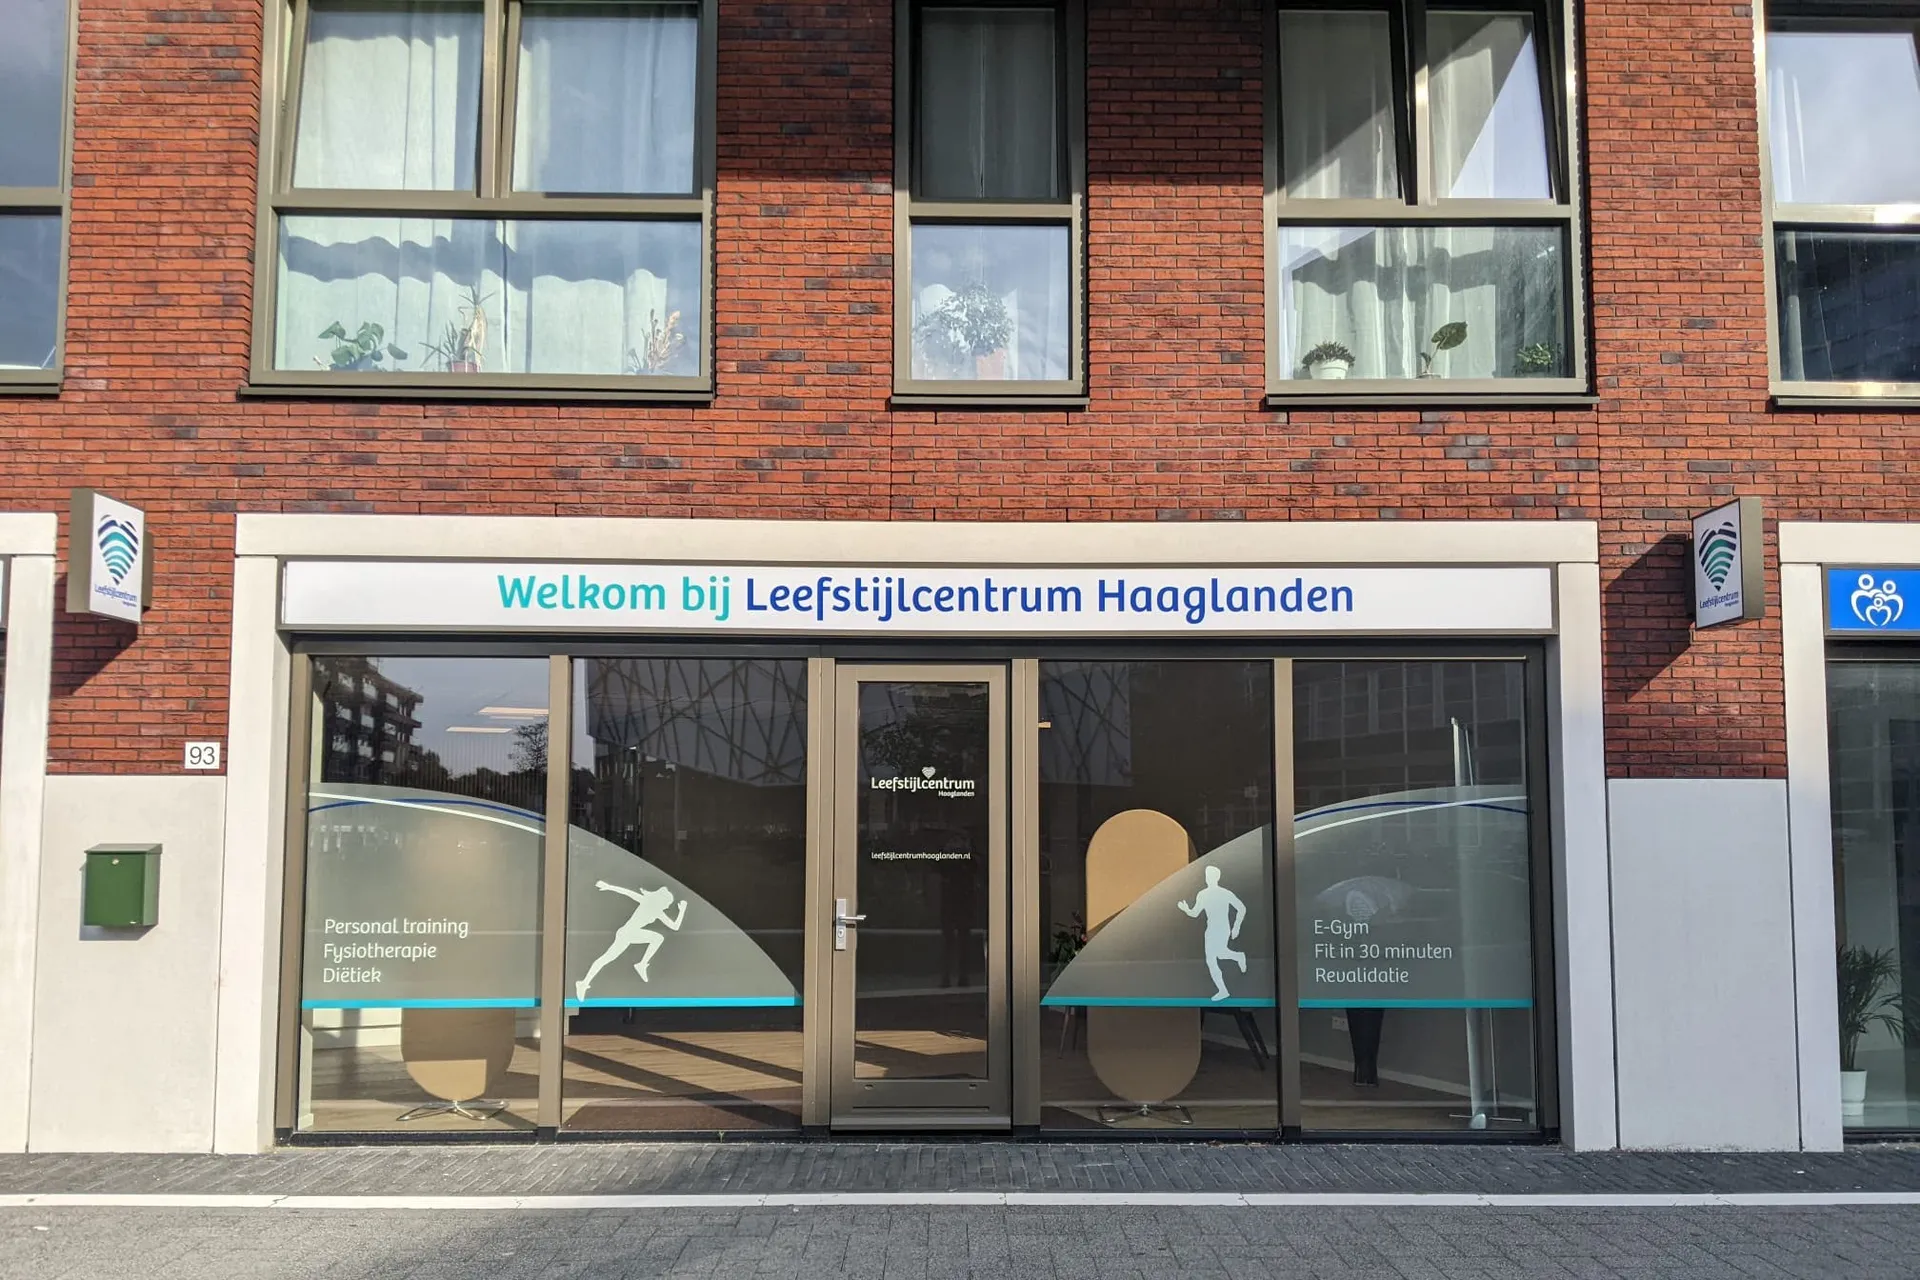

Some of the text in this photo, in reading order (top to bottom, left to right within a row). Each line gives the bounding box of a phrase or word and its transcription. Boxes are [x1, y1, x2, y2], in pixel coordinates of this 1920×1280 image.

[497, 574, 1354, 625] Welkom bij Leefstijlcentrum Haaglanden
[190, 746, 215, 765] 93
[871, 777, 975, 792] Leefstijlcentrum
[871, 852, 971, 861] leefstijlcentrumhaaglanden.nl
[324, 918, 469, 938] Personal training
[1314, 919, 1369, 939] E-Gym
[323, 942, 437, 963] Fysiotherapie
[1315, 943, 1452, 959] Fit in 30 minuten
[323, 967, 381, 983] Diëtiek
[1315, 967, 1409, 983] Revalidatie
